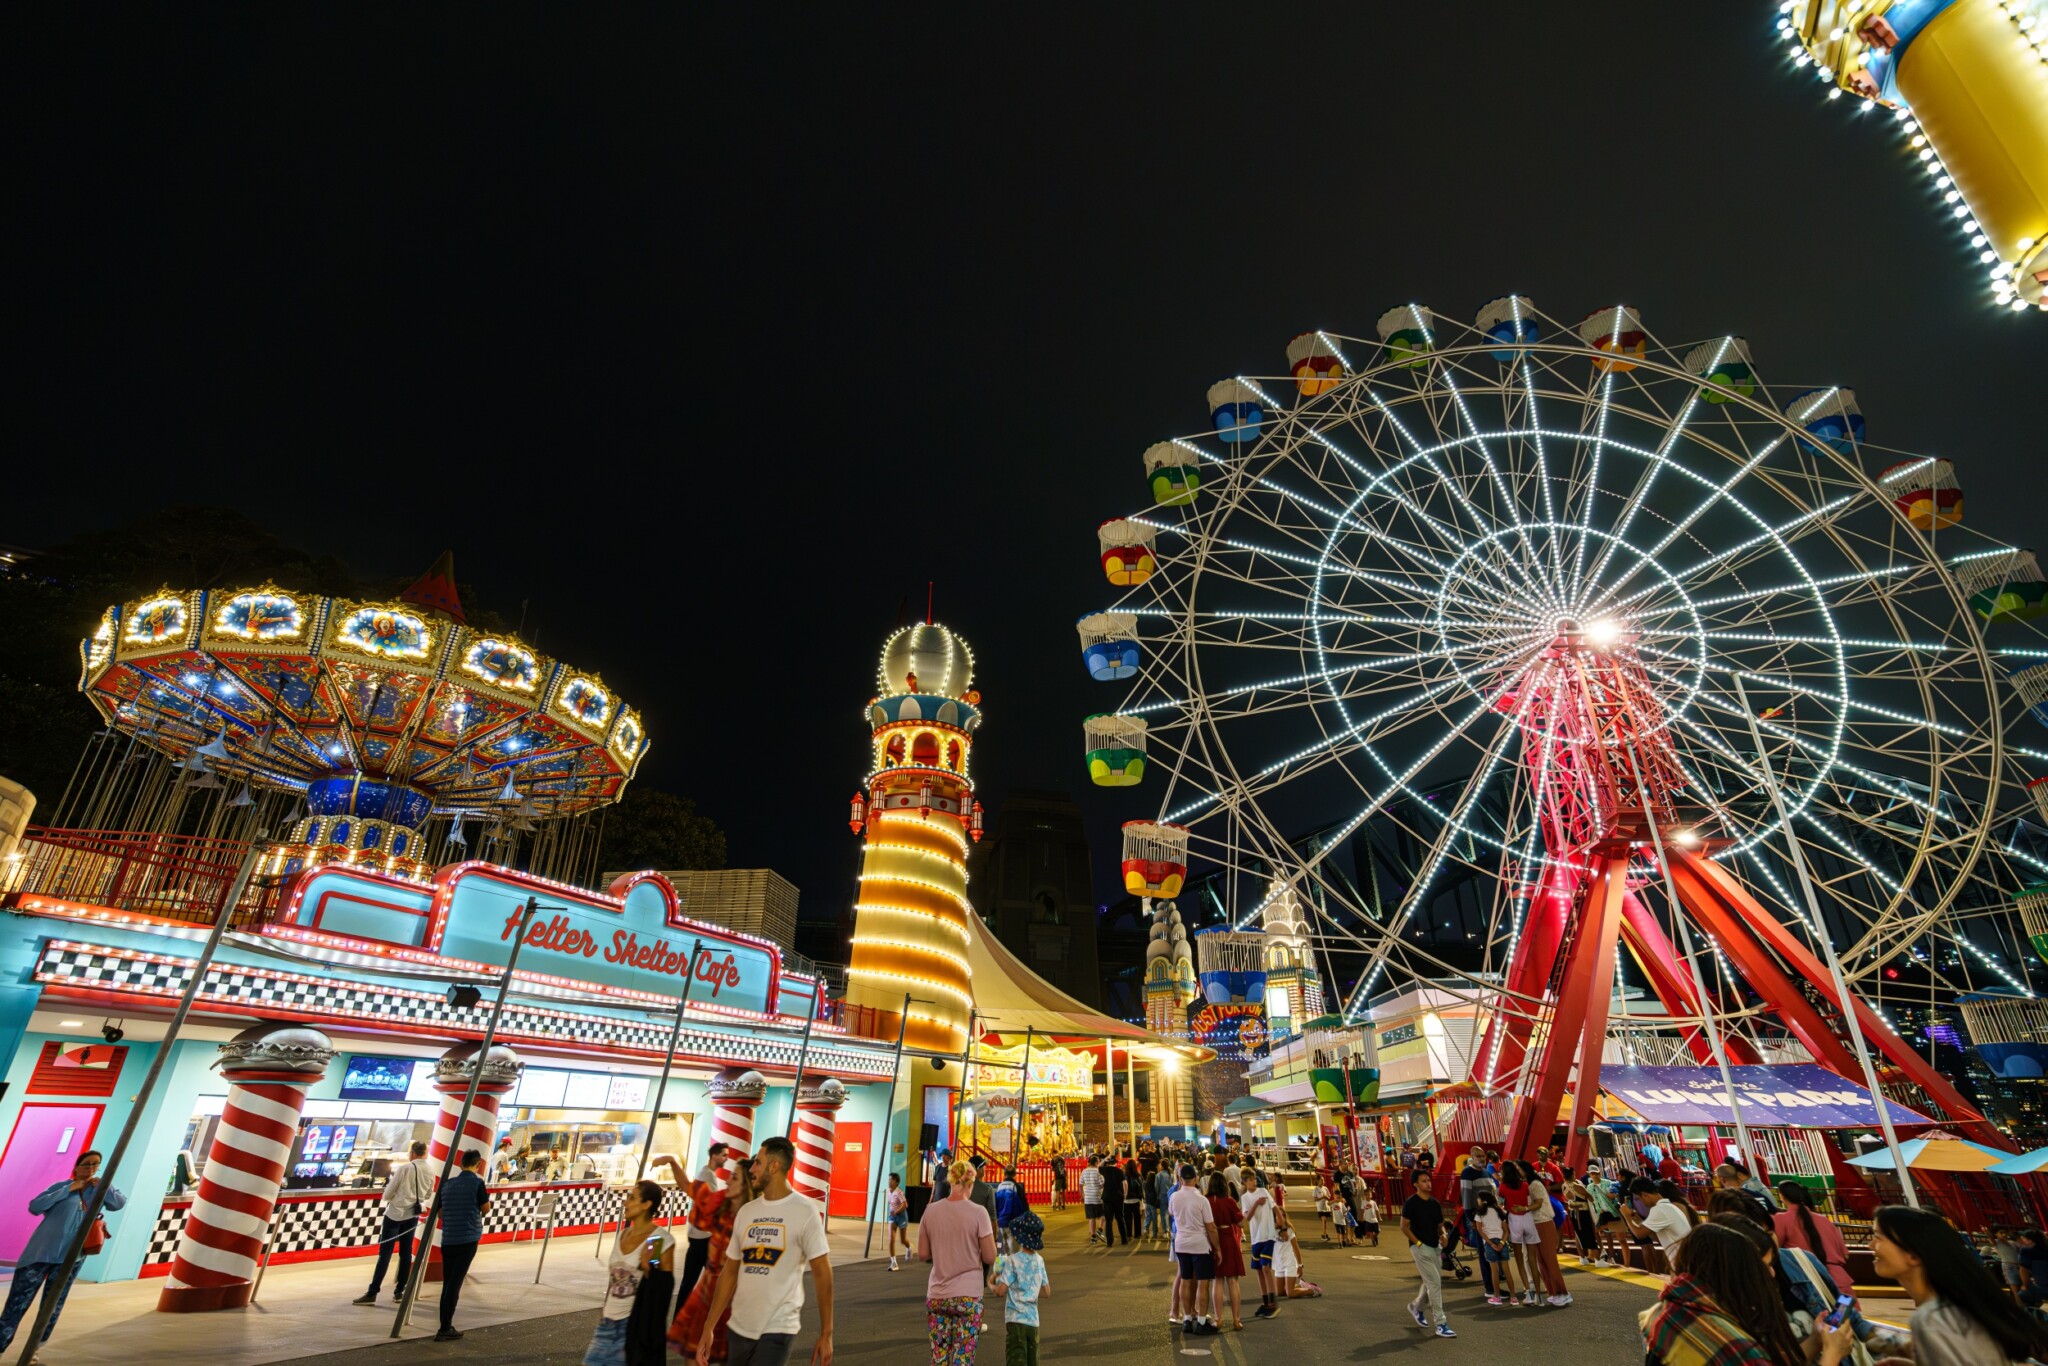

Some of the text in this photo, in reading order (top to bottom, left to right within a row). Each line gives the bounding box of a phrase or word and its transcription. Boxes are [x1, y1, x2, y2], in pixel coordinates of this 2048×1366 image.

[501, 904, 740, 998] Helter Skelter Cafe
[1191, 1004, 1219, 1040] JUST
[1217, 1005, 1241, 1021] FOR
[1623, 1088, 1872, 1108] LUNA PARK
[748, 1227, 779, 1238] Corona
[745, 1266, 770, 1275] MEXICO
